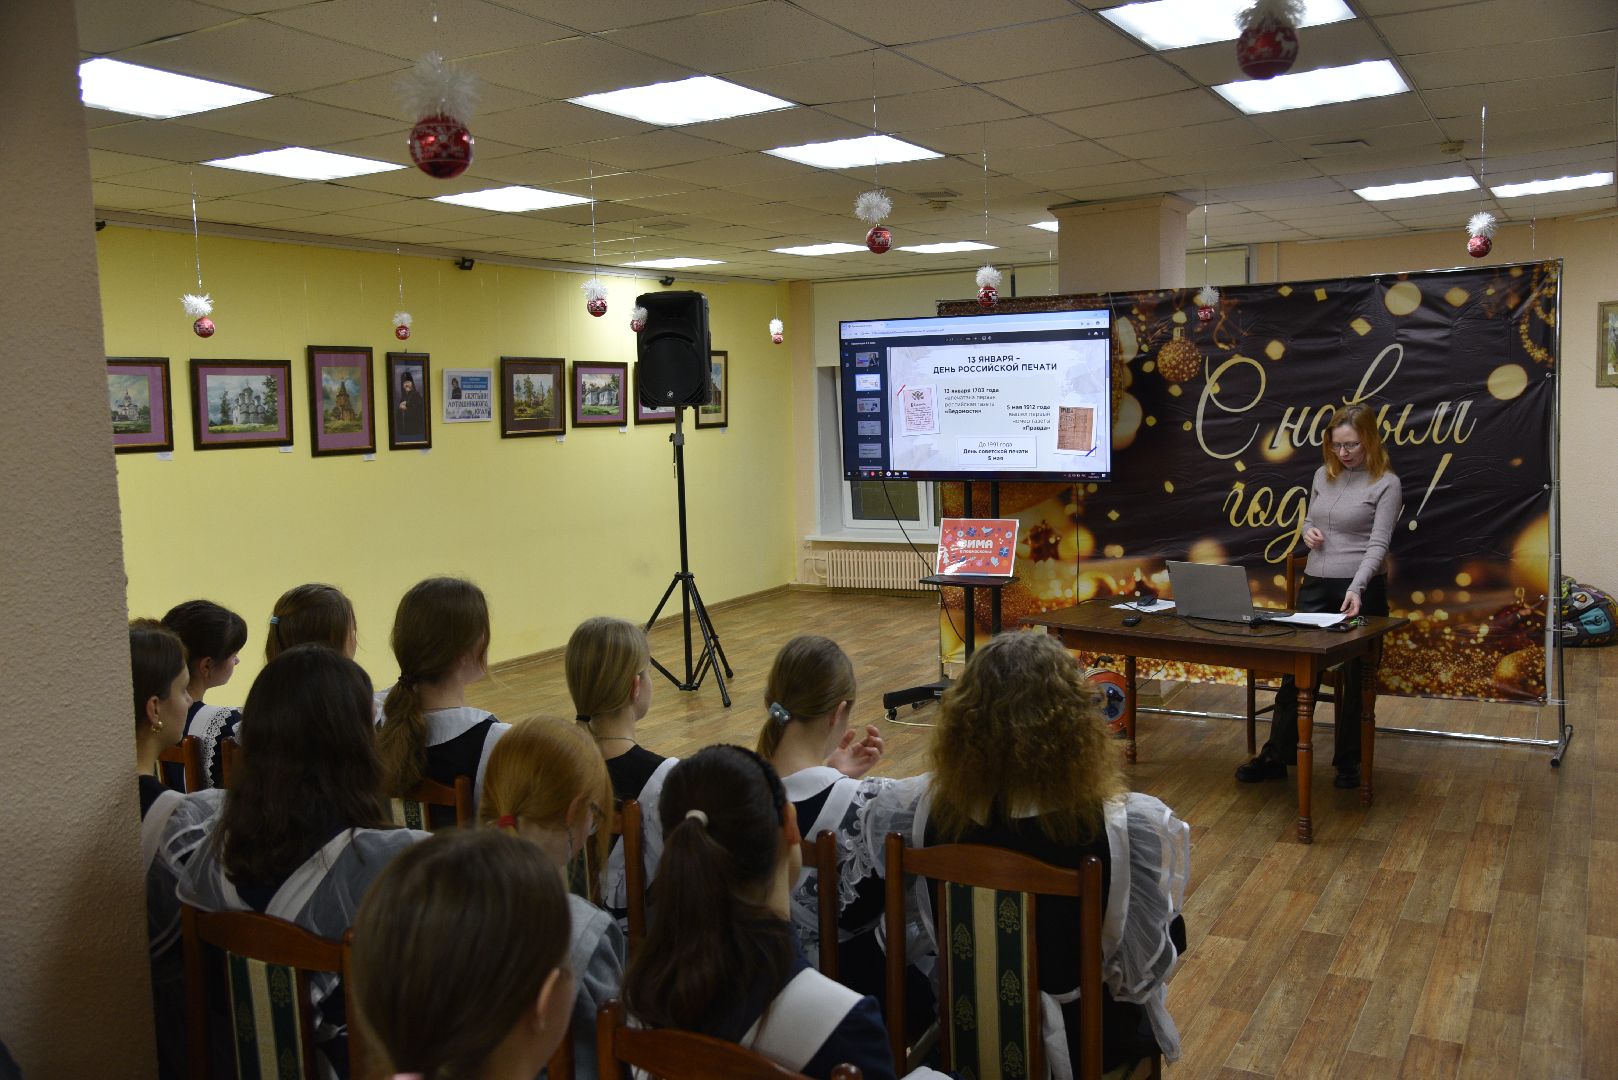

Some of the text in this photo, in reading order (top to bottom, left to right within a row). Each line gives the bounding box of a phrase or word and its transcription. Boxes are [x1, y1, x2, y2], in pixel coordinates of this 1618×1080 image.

[978, 355, 1014, 363] ЯНВАРЯ
[933, 362, 1057, 374] ДЕНЬ РОССИЙСКОЙ ПЕЧАТИ
[1196, 356, 1267, 460] С
[1222, 452, 1453, 564] год!
[958, 539, 994, 549] ЗИМА
